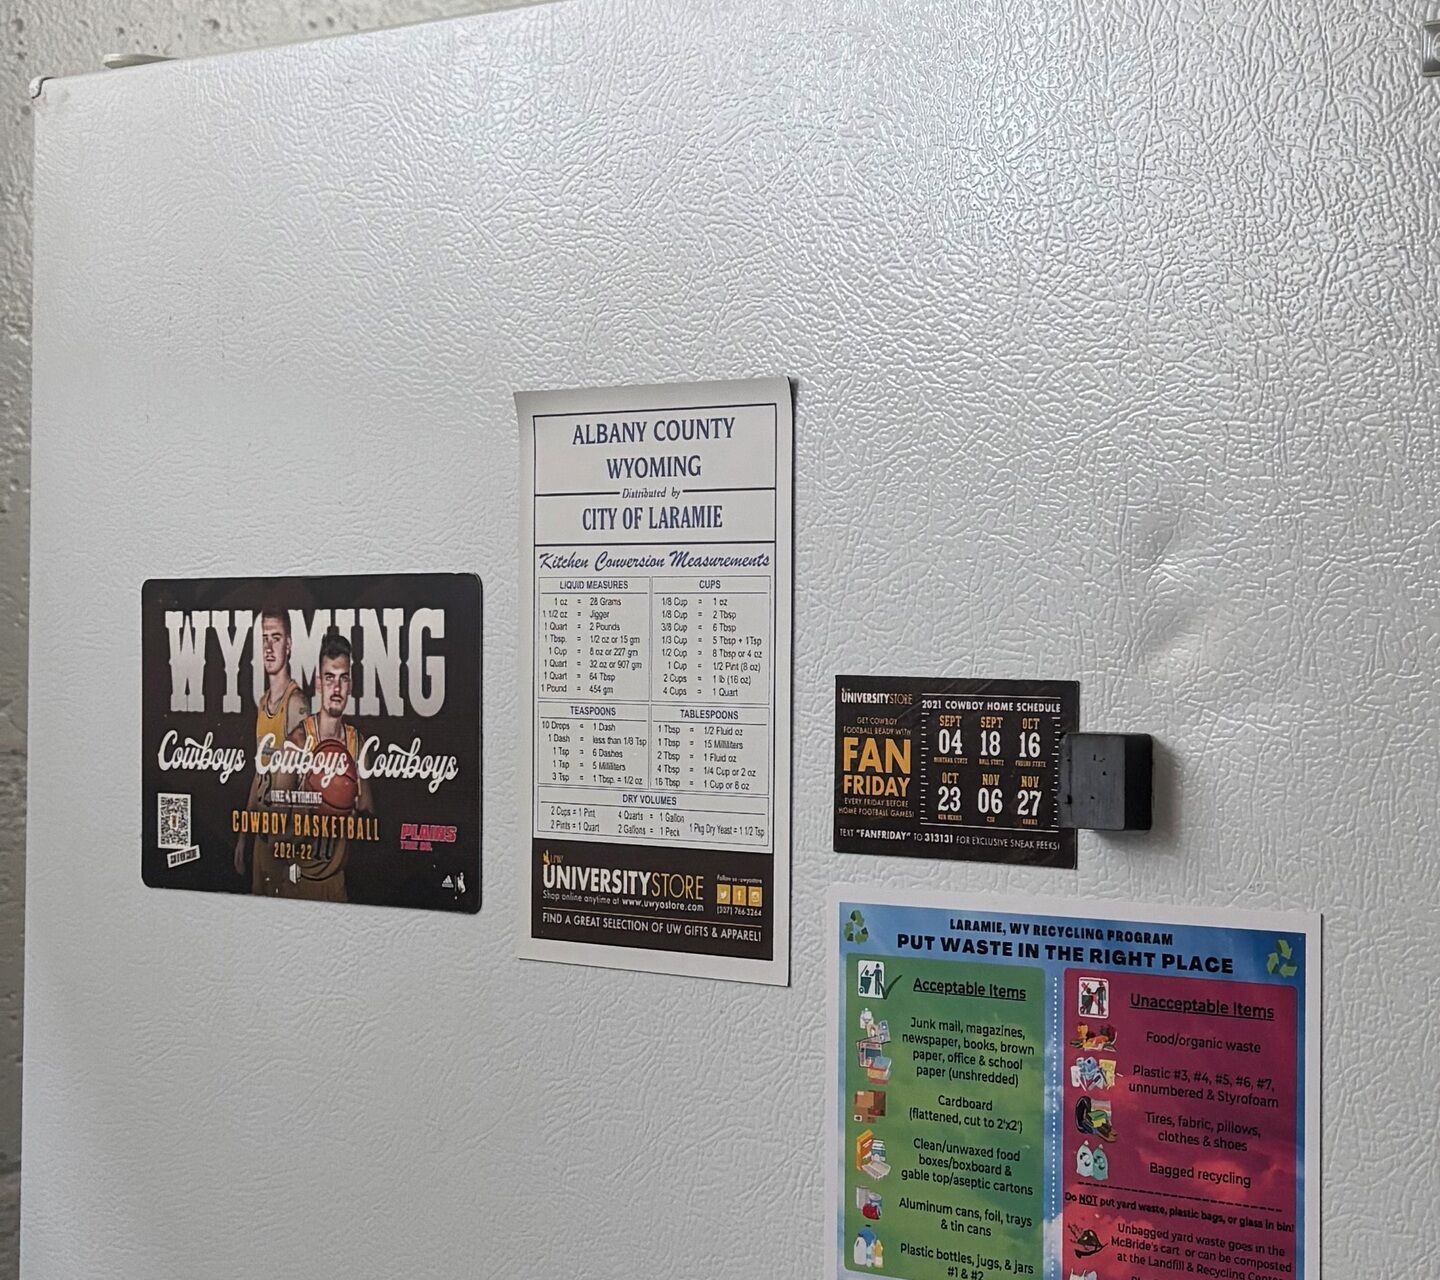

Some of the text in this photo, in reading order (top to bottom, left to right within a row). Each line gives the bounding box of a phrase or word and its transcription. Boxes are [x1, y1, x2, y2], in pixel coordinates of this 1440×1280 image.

[572, 417, 735, 445] ALBANY COUNTY
[607, 455, 702, 479] WYOMING
[622, 488, 680, 498] Distributed by
[582, 505, 723, 531] CITY OF LARAMIE
[539, 550, 770, 571] Kitchen Conversion Measurements
[560, 580, 628, 589] LIQUID MEASURES
[699, 580, 721, 588] CUPS
[590, 610, 609, 620] Jigger
[842, 692, 912, 704] UNIVERSITYSTORE
[922, 700, 1061, 713] 2021 COWBOY HOME SCHEDULE
[570, 706, 616, 716] TEASPOONS
[680, 709, 739, 720] TABLESPOONS
[940, 715, 962, 726] SEPT
[704, 727, 713, 735] 1/2
[716, 727, 733, 735] Fluid
[844, 726, 873, 734] FOOTBALL
[980, 717, 1003, 728] SEPT
[1022, 718, 1040, 729] OCT
[939, 729, 962, 755] 04
[980, 730, 1001, 756] 18
[1019, 732, 1040, 758] 16
[157, 730, 459, 793] Cowboys Cowboys Cowboys
[844, 737, 911, 774] FAN
[844, 775, 910, 797] FRIDAY
[942, 772, 959, 784] OCT
[982, 774, 1000, 786] NOV
[1021, 776, 1039, 787] NOV
[622, 794, 677, 805] DRY VOLUMES
[938, 786, 961, 812] 23
[978, 787, 1003, 814] 06
[1017, 790, 1042, 816] 27
[859, 808, 888, 817] FOOTBALL
[232, 810, 379, 841] COWBOY BASKETBALL
[839, 829, 854, 837] TEXT
[924, 834, 953, 843] 313131
[956, 836, 970, 844] FOR
[972, 837, 1008, 847] EXCLUSIVE
[1010, 839, 1034, 849] SNEAK
[1037, 841, 1060, 850] PEEKS!
[274, 842, 312, 860] 2021-22
[543, 864, 704, 900] UNIVERSITYSTORE
[543, 890, 560, 901] Shop
[561, 893, 582, 901] online
[584, 895, 610, 904] anytime
[622, 897, 704, 912] www.uwyostore.com
[543, 913, 761, 941] FIND A GREAT SELECTION OF UW GIFTS & APPAREL!
[950, 919, 1173, 945] LARAMIE, WY RECYCLING PROGRAM
[898, 934, 1234, 974] PUT WASTE IN THE RIGHT PLACE
[913, 978, 1027, 1000] Acceptable Items
[1130, 993, 1274, 1020] Unacceptable Items
[910, 1017, 1025, 1040] Junk mail, magazines,
[902, 1033, 1034, 1055] newspaper, books, brown
[1146, 1031, 1261, 1053] Food/organic waste
[913, 1049, 1023, 1070] paper, office & school
[916, 1065, 1019, 1087] paper (unshredded)
[1133, 1065, 1274, 1092] Plastic #3, #4, #5, #6, #7,
[938, 1095, 993, 1111] Cardboard
[1128, 1084, 1279, 1108] unnumbered & Styrofoam
[909, 1108, 961, 1125] (flattened,
[964, 1116, 981, 1127] cut
[983, 1117, 994, 1128] to
[913, 1138, 1021, 1162] Clean/unwaxed food
[919, 1154, 1012, 1177] boxes/boxboard &
[1150, 1163, 1251, 1188] Bagged recycling
[901, 1170, 1033, 1195] gable top/aseptic cartons
[899, 1198, 1032, 1227] Aluminum cans, foil, trays
[940, 1220, 992, 1236] & tin cans
[900, 1243, 1033, 1274] Plastic bottles, jugs, & jars
